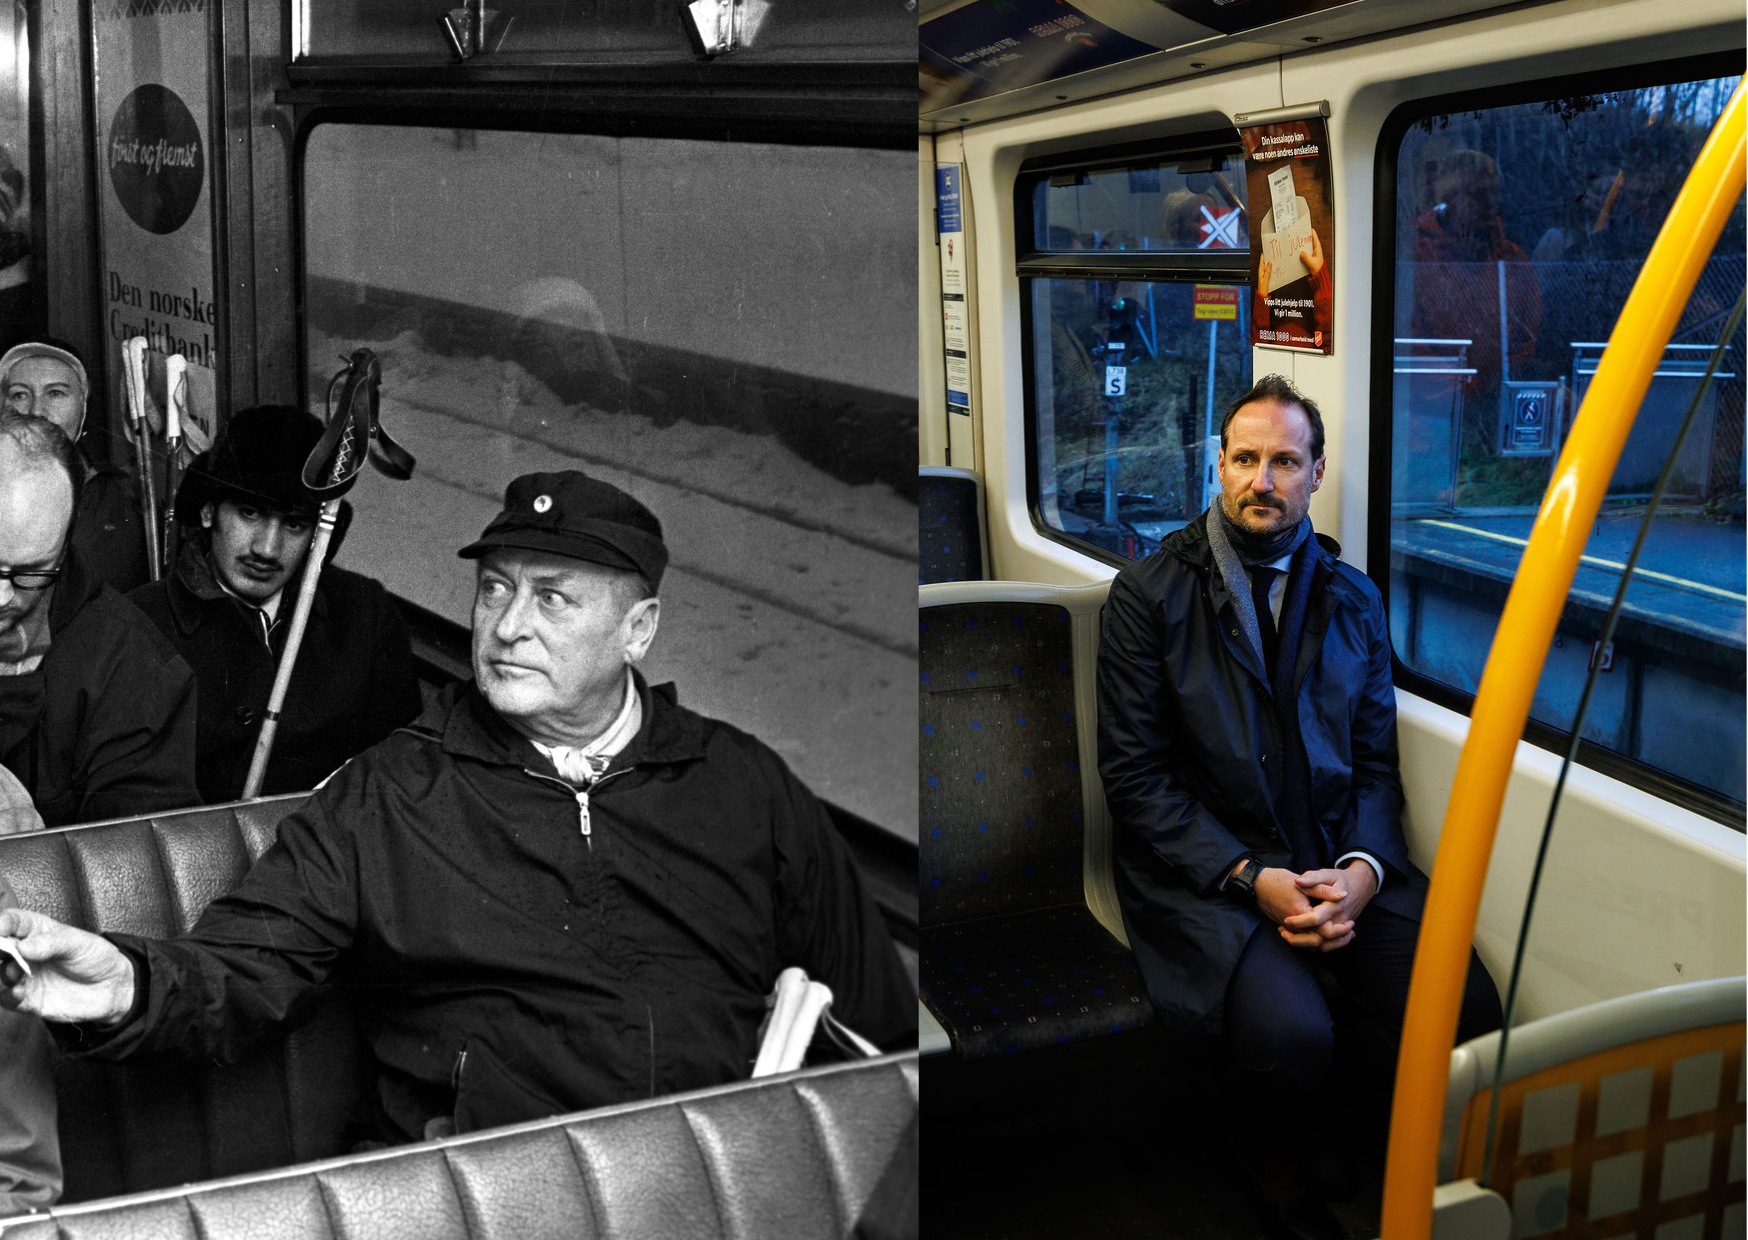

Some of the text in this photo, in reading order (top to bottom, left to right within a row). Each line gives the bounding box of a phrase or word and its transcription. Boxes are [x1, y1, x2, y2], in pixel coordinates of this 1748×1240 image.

[1261, 132, 1304, 146] Din kassalapp kan
[140, 144, 154, 176] og
[1252, 144, 1319, 160] være noen andres ønskeliste
[1269, 238, 1282, 260] Til
[109, 271, 215, 325] Den norske
[1263, 298, 1275, 307] Vipps
[1303, 299, 1314, 308] 1901.
[1288, 309, 1303, 318] million.
[1259, 329, 1276, 341] REMA
[1276, 331, 1289, 342] 1000
[1110, 377, 1121, 394] S
